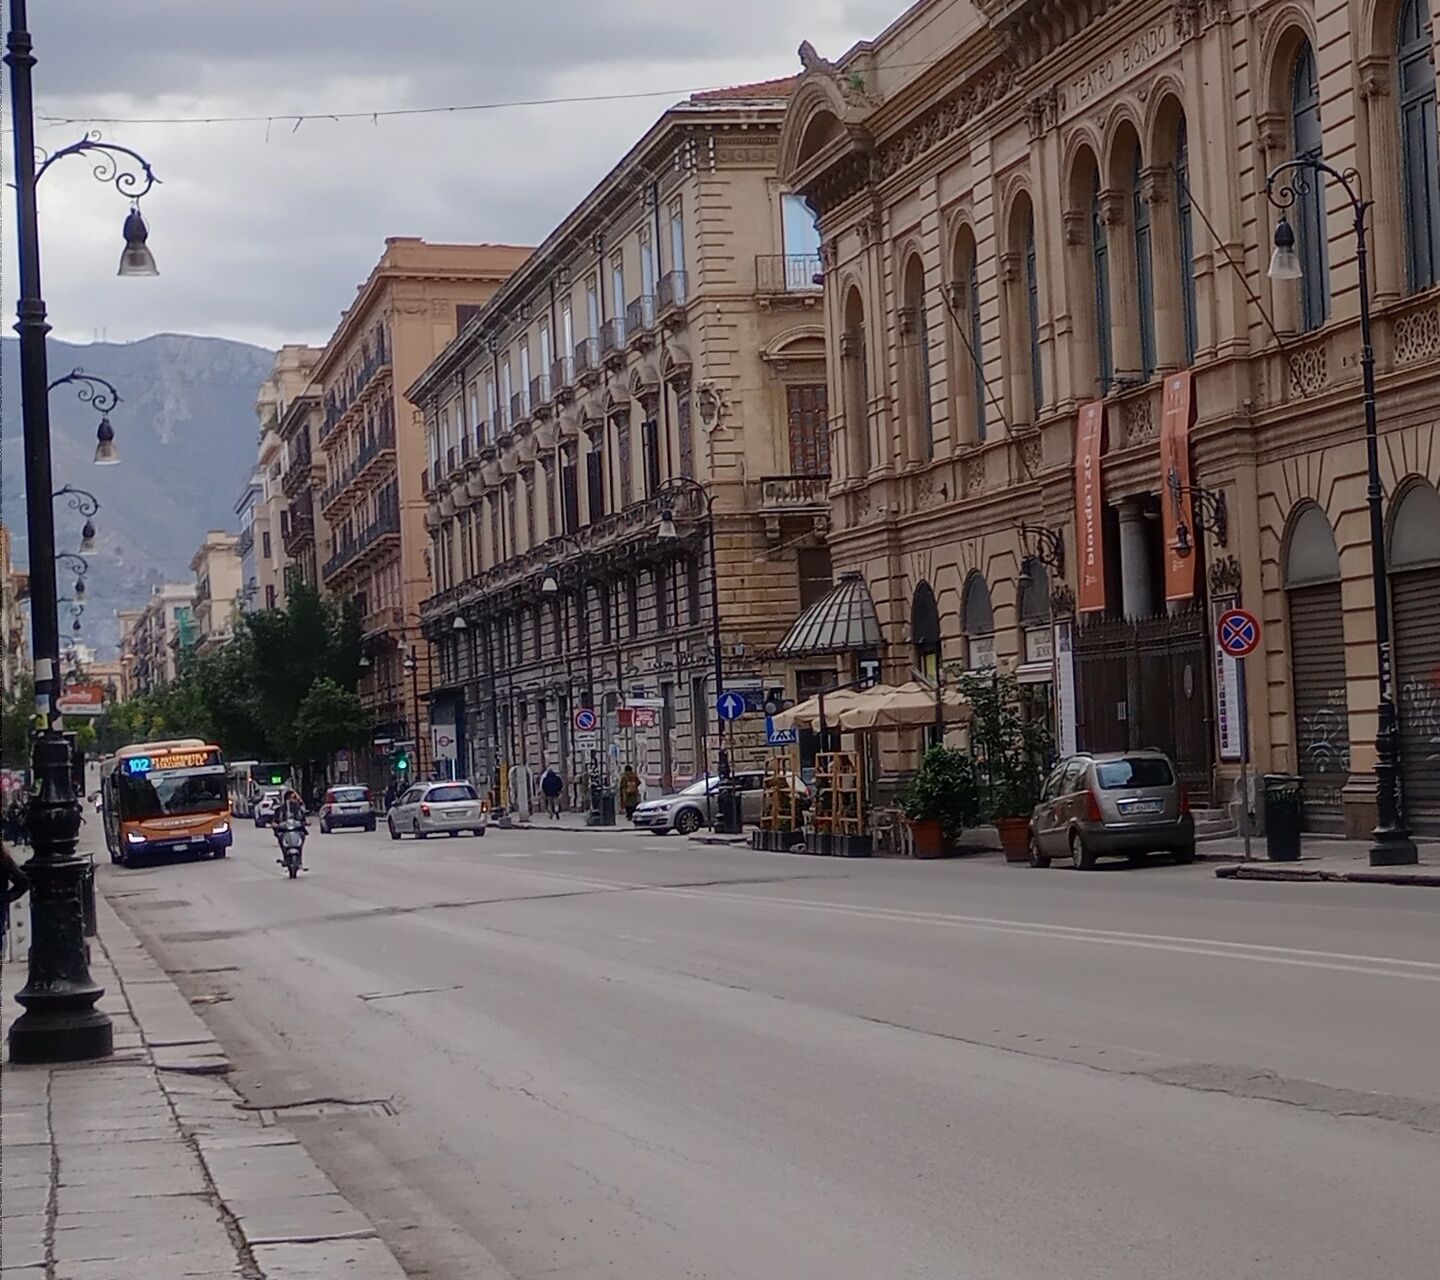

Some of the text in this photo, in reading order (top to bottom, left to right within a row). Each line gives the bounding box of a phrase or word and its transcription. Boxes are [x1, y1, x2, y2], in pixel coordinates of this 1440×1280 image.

[1072, 25, 1166, 105] TEATRO BIONDO
[129, 758, 151, 773] 102
